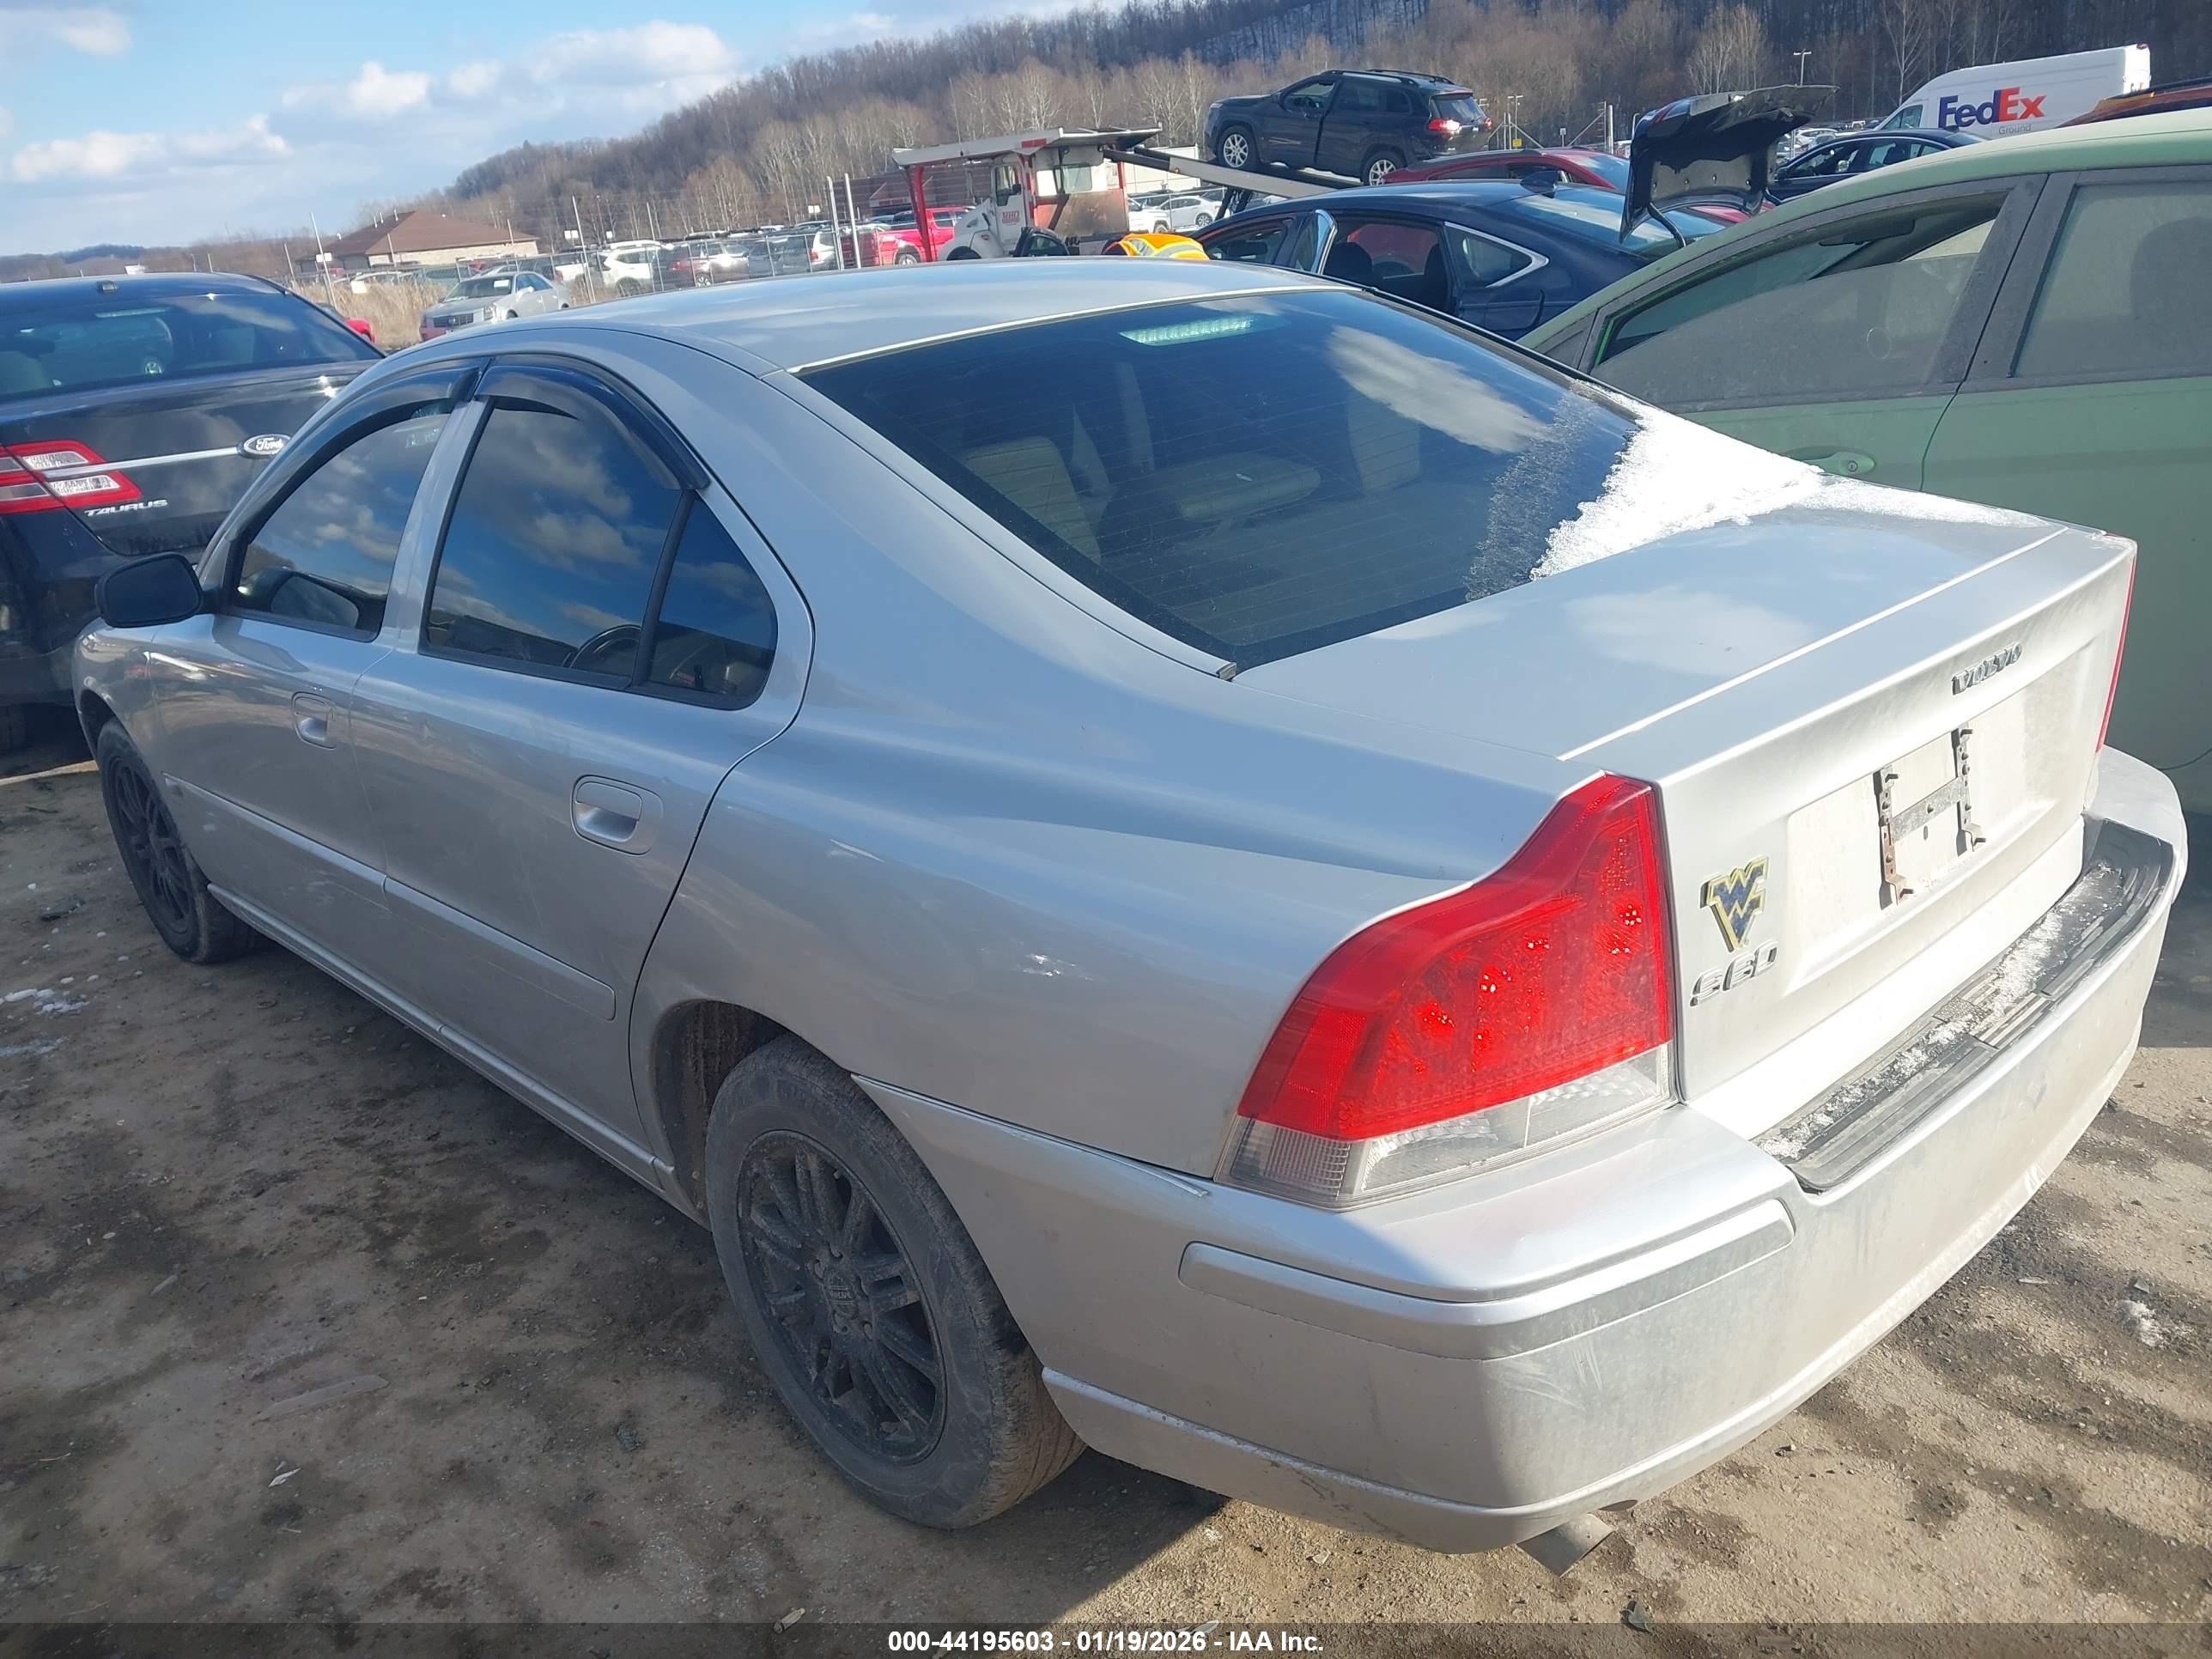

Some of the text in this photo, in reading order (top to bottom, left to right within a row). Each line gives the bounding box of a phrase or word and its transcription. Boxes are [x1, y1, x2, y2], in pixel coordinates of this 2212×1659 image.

[1938, 87, 2046, 129] FedEx
[1998, 124, 2032, 135] Ground
[255, 437, 284, 451] Ford
[84, 499, 168, 517] TAURUS
[1951, 642, 2022, 696] VOLVO
[1690, 939, 1778, 1007] S60
